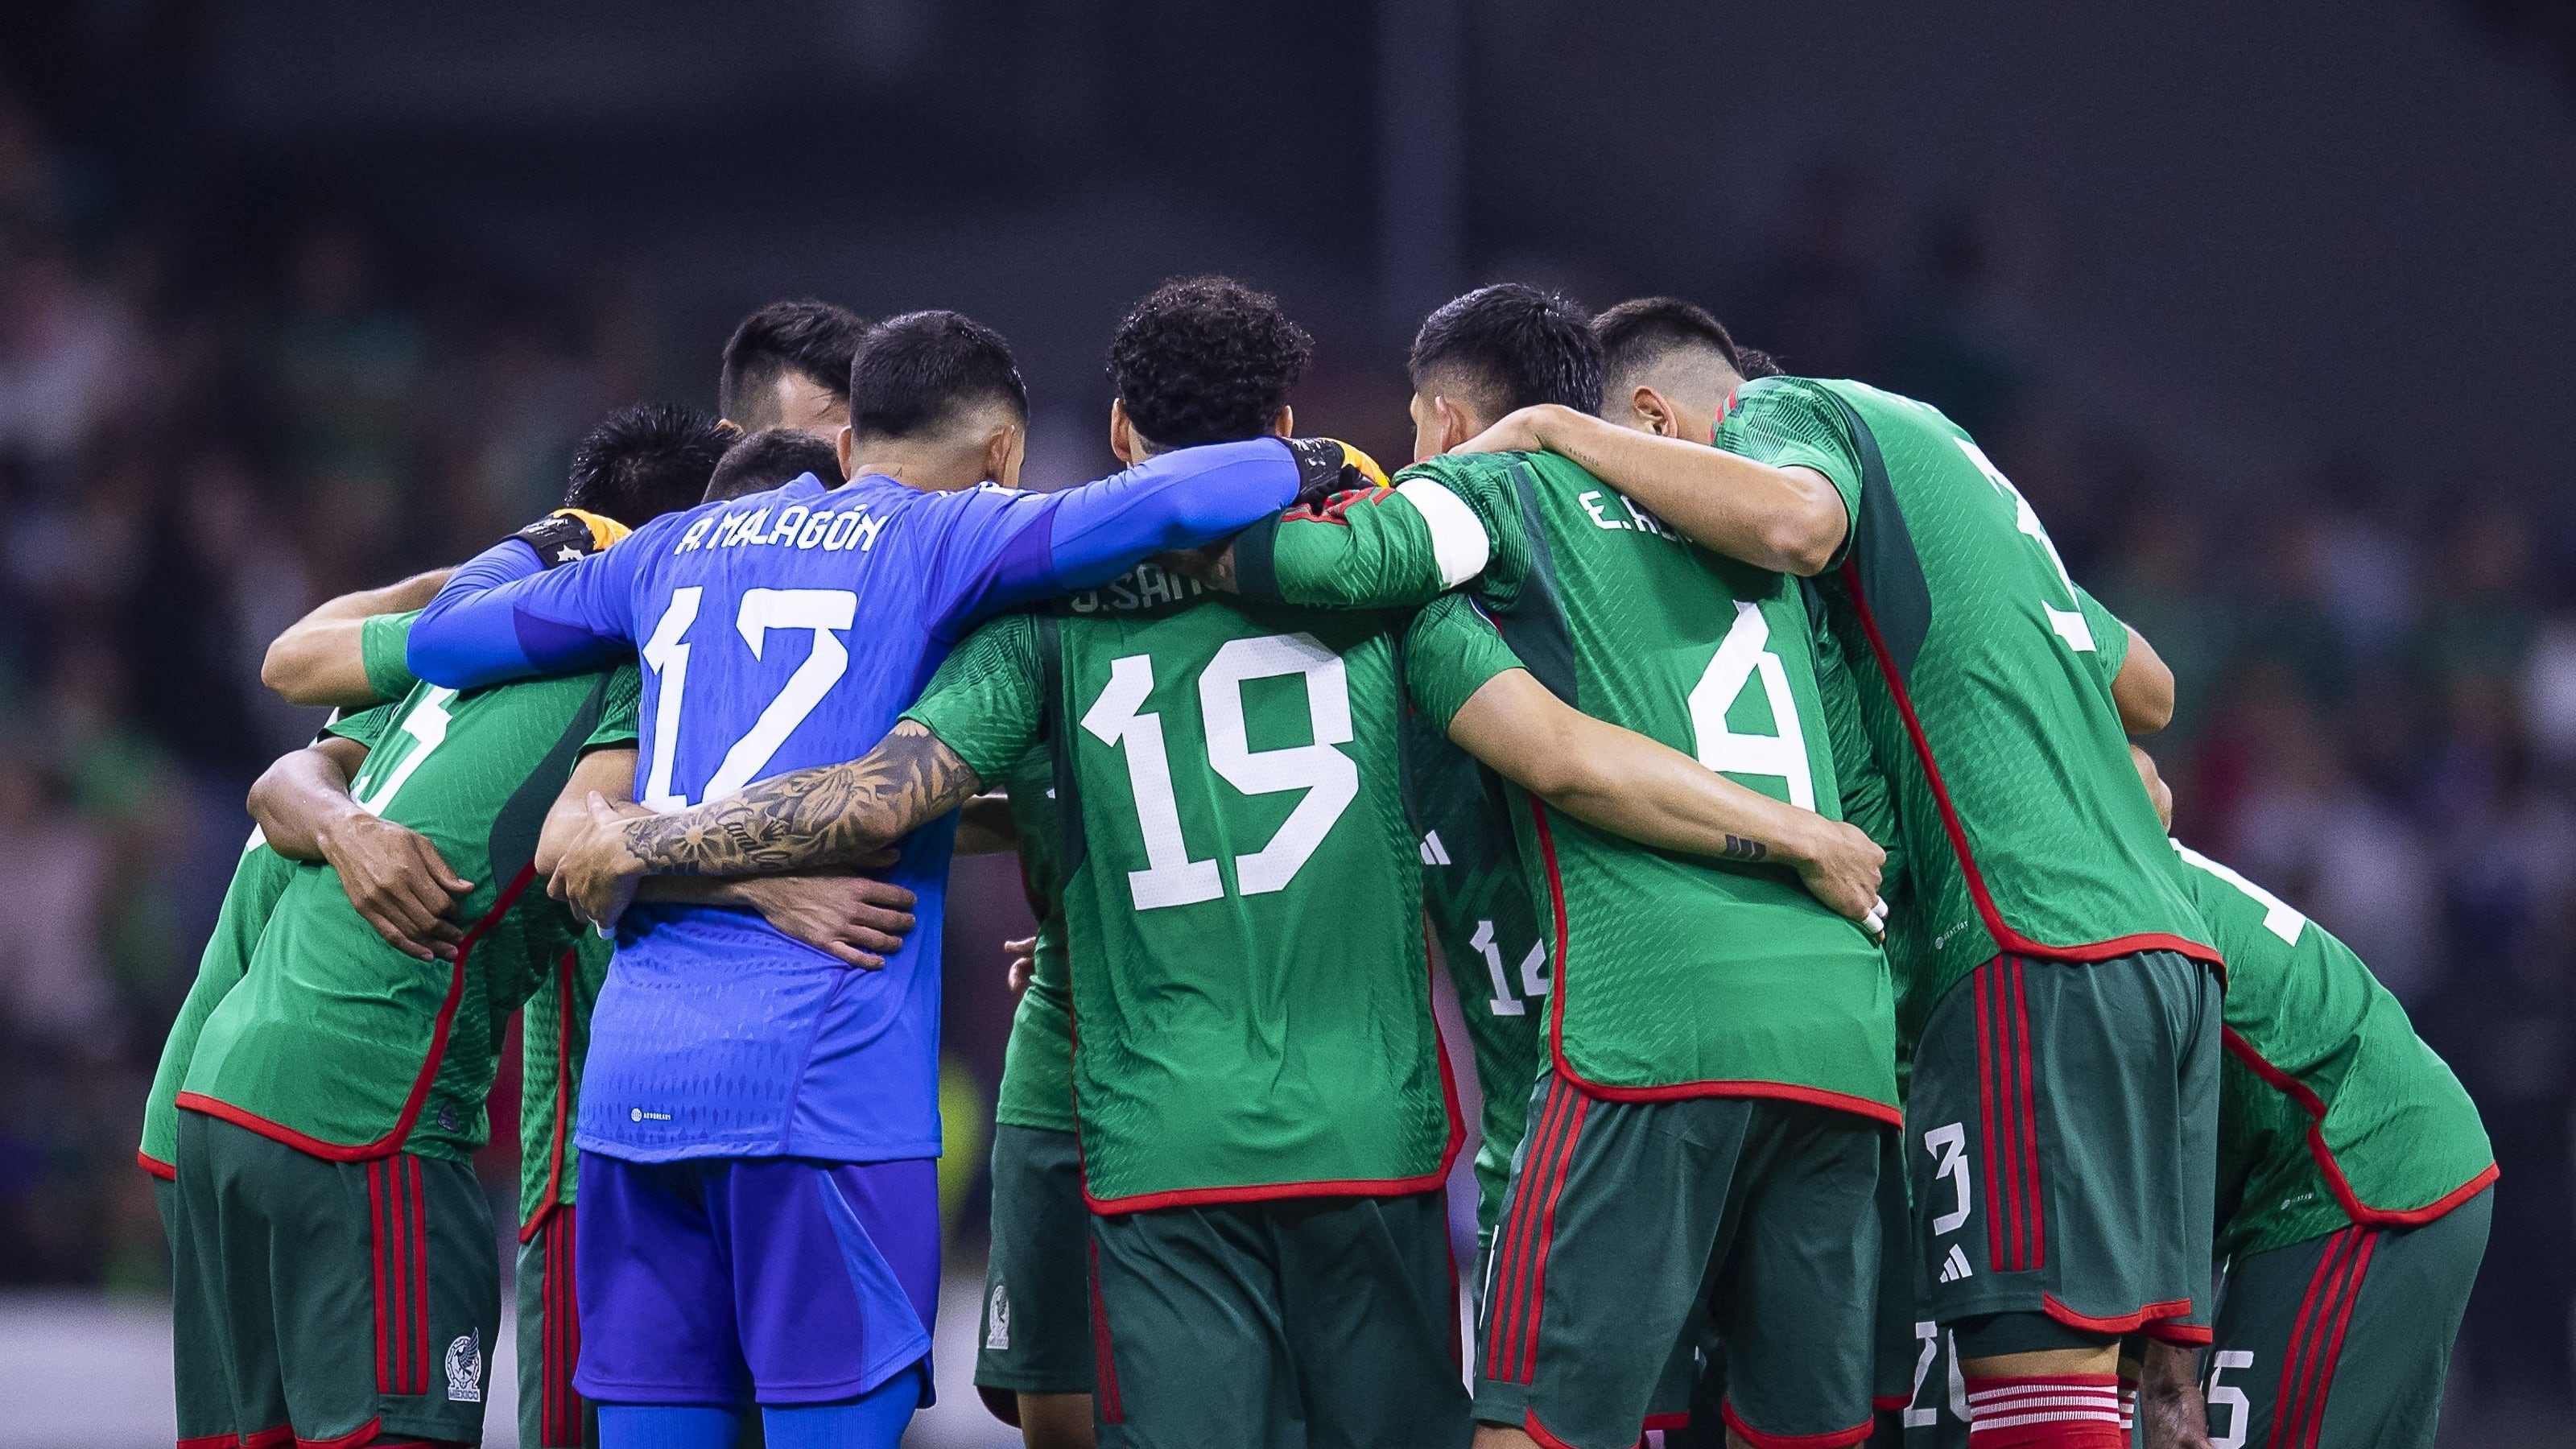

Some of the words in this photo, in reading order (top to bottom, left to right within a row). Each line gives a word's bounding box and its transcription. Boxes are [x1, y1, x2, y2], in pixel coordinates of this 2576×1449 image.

[640, 585, 860, 815] 17
[1080, 631, 1360, 910] 19
[1687, 599, 1817, 814] 4
[1924, 1121, 1971, 1236] 3
